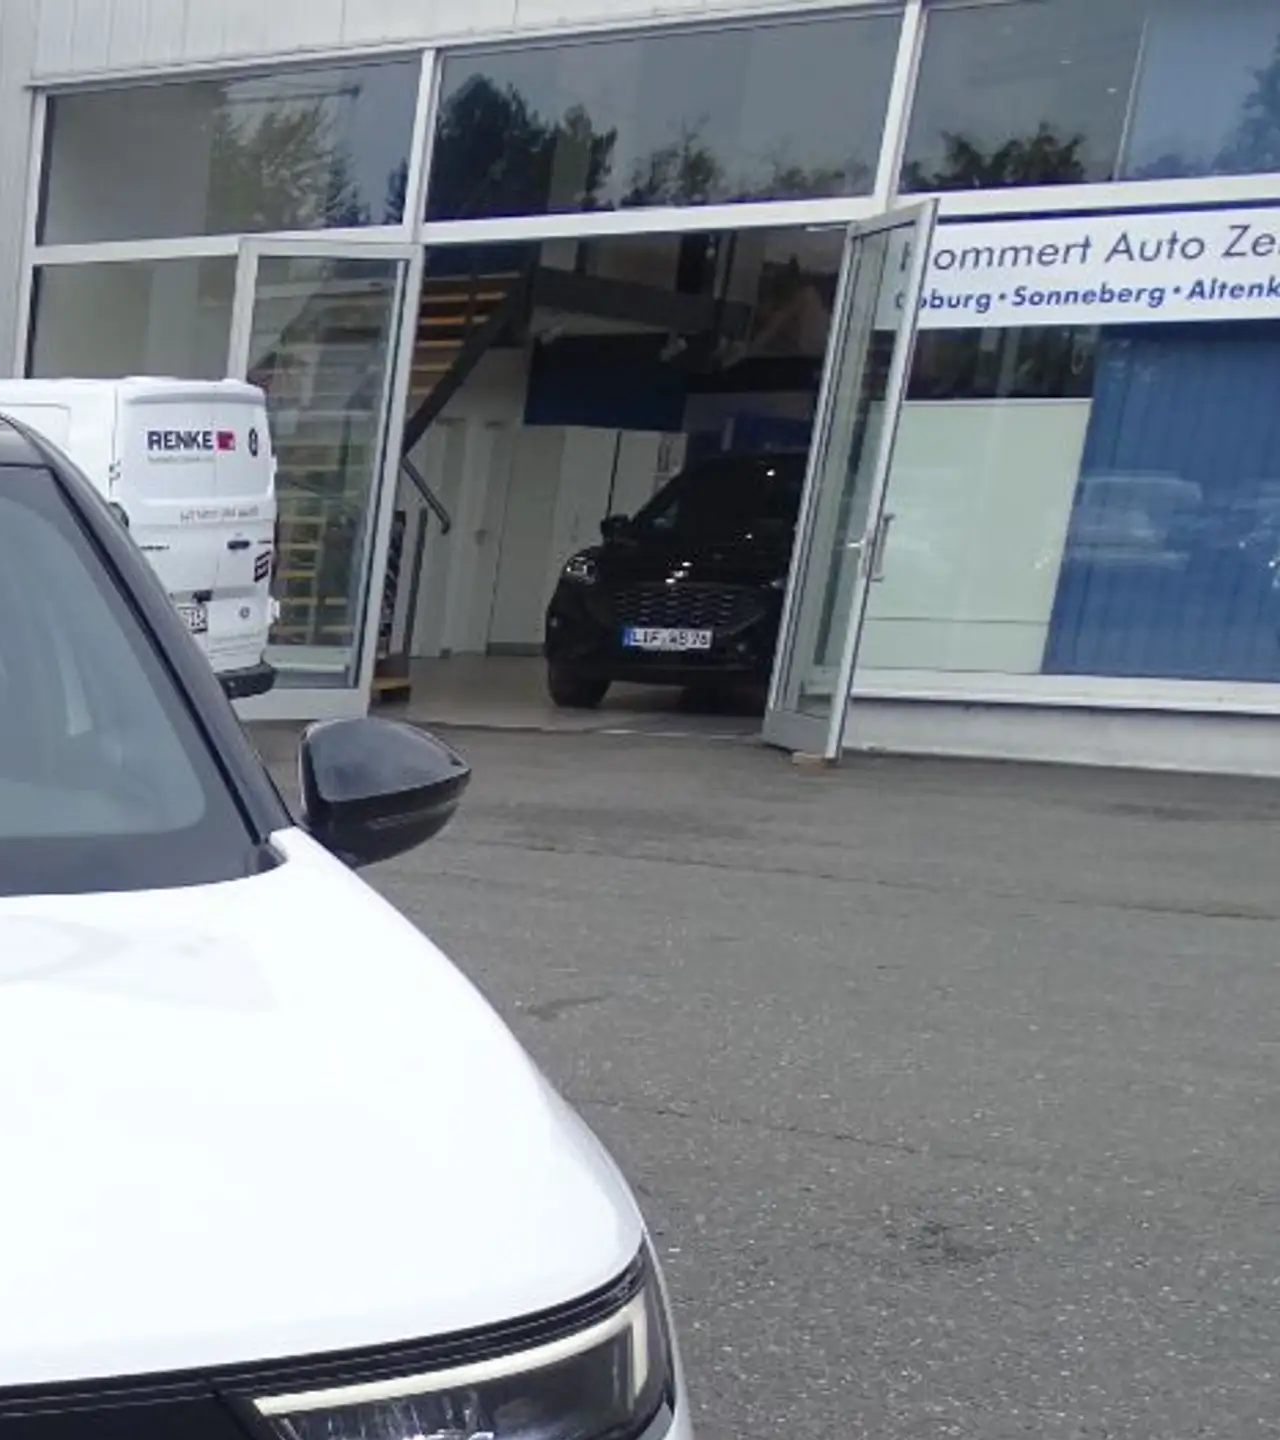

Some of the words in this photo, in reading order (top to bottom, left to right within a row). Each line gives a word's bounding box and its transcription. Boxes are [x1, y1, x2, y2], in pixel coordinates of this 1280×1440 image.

[1104, 230, 1206, 263] Auto
[1221, 223, 1280, 258] Ze
[1011, 281, 1166, 309] Sonneberg
[146, 430, 214, 451] RENKE
